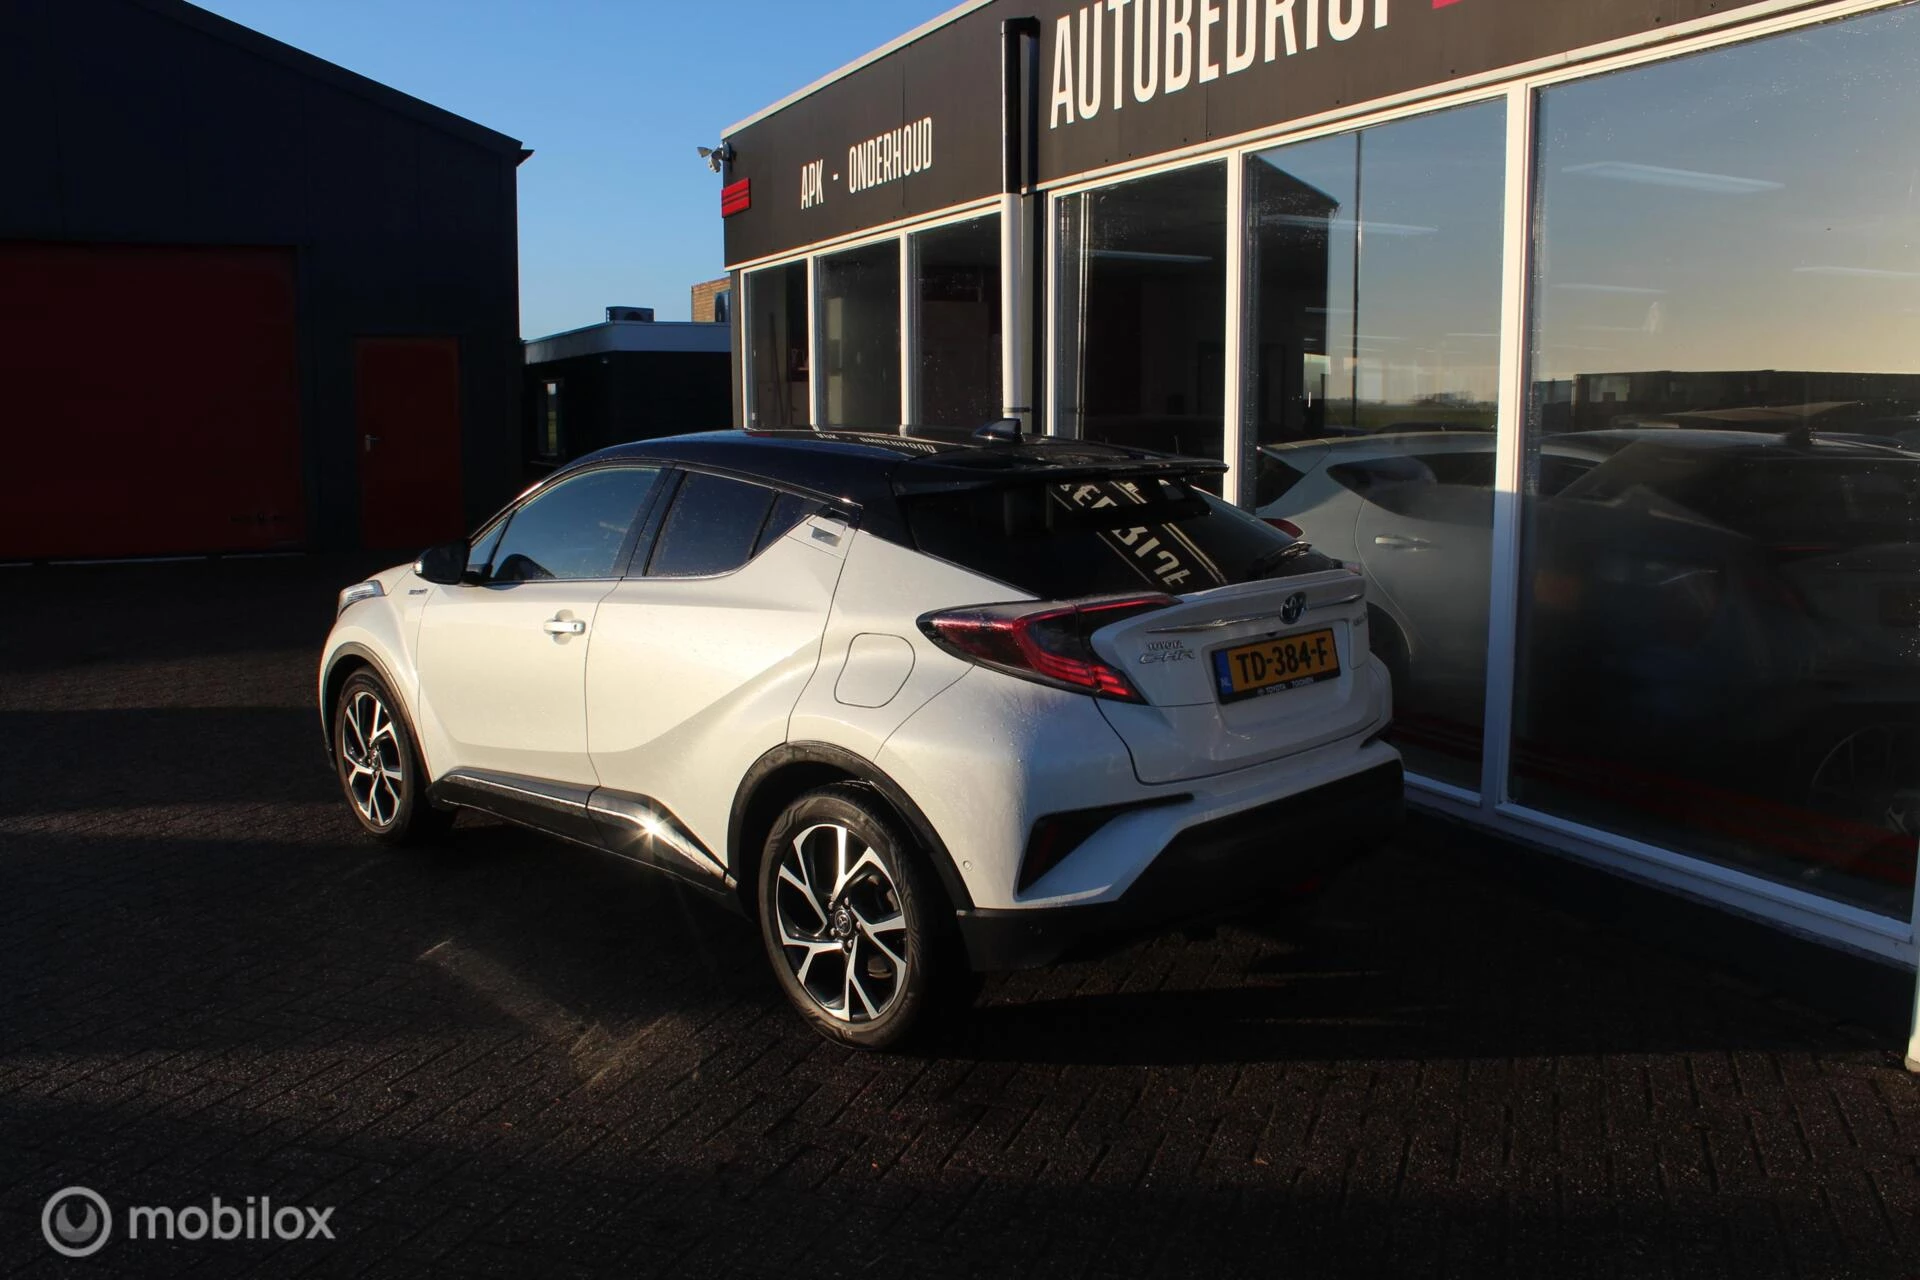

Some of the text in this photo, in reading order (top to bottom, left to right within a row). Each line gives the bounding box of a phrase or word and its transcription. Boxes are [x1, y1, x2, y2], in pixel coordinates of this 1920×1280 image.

[1050, 0, 1388, 130] AUTOBED
[800, 158, 825, 210] APK
[848, 116, 934, 195] ONDERHOUD
[1236, 637, 1328, 685] TD-384-F
